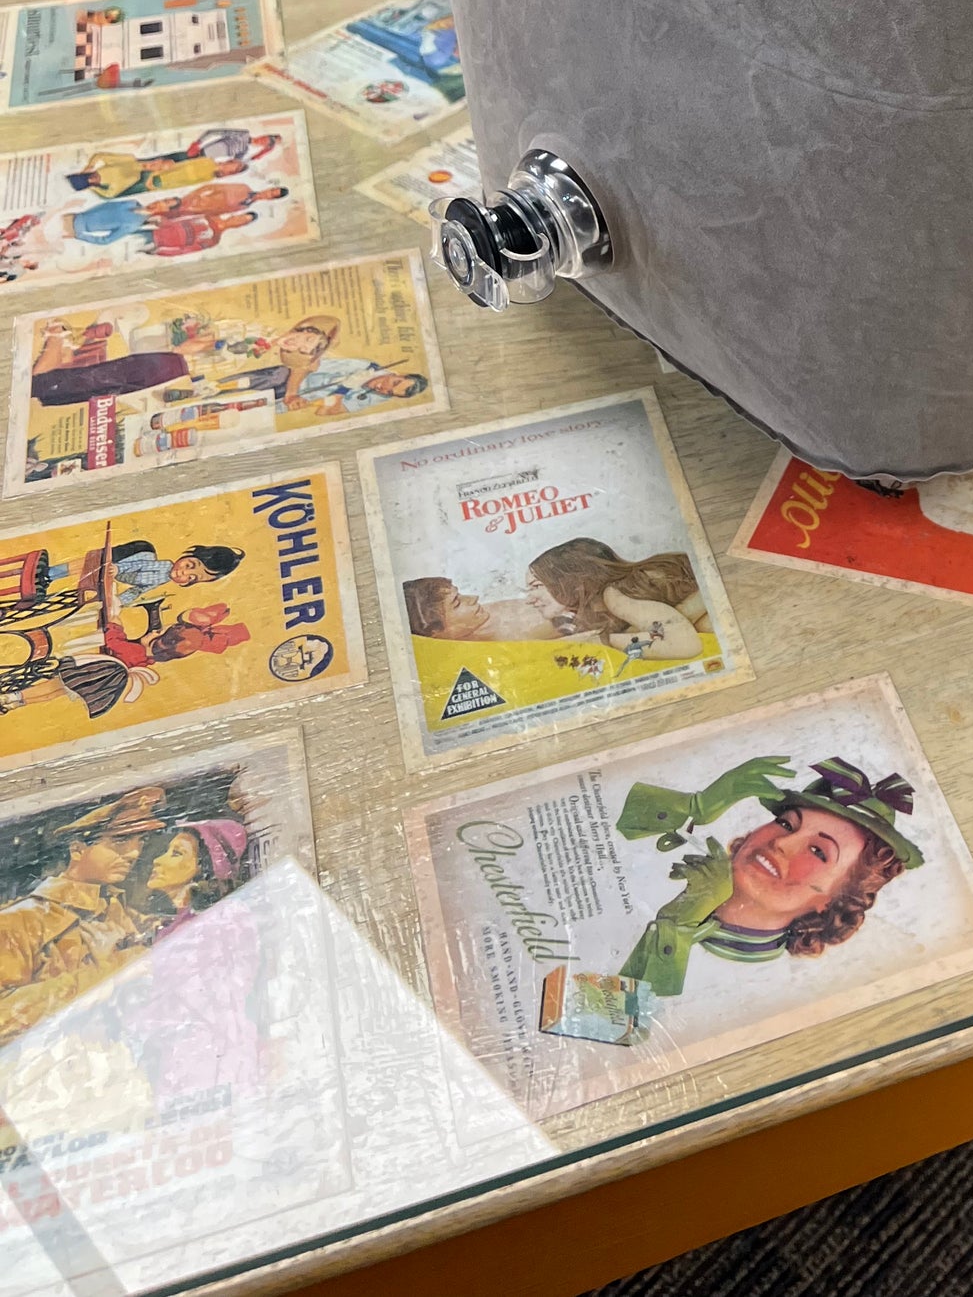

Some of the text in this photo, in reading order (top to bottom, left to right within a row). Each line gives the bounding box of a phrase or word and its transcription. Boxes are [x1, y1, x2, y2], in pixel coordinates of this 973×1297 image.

[95, 396, 113, 468] Budweiser
[401, 457, 428, 472] No
[433, 437, 518, 464] ordinary
[520, 428, 557, 444] love
[460, 485, 560, 521] ROMEO
[484, 492, 593, 535] & JULIET
[252, 478, 326, 630] KÖHLER
[451, 686, 490, 703] GENERAL
[455, 680, 480, 693] FOR
[447, 693, 498, 715] EXHIBITION
[588, 769, 602, 782] The
[568, 794, 584, 824] Original
[591, 782, 608, 820] Chesterfield
[575, 823, 586, 837] and
[580, 792, 595, 820] designer
[588, 820, 602, 842] Merry
[577, 836, 594, 865] different
[605, 839, 620, 864] created
[612, 865, 623, 874] by
[615, 874, 628, 892] New
[456, 820, 581, 965] Chesterfield
[620, 891, 634, 915] York's
[479, 926, 495, 960] MORE
[487, 965, 509, 1023] SMOKING
